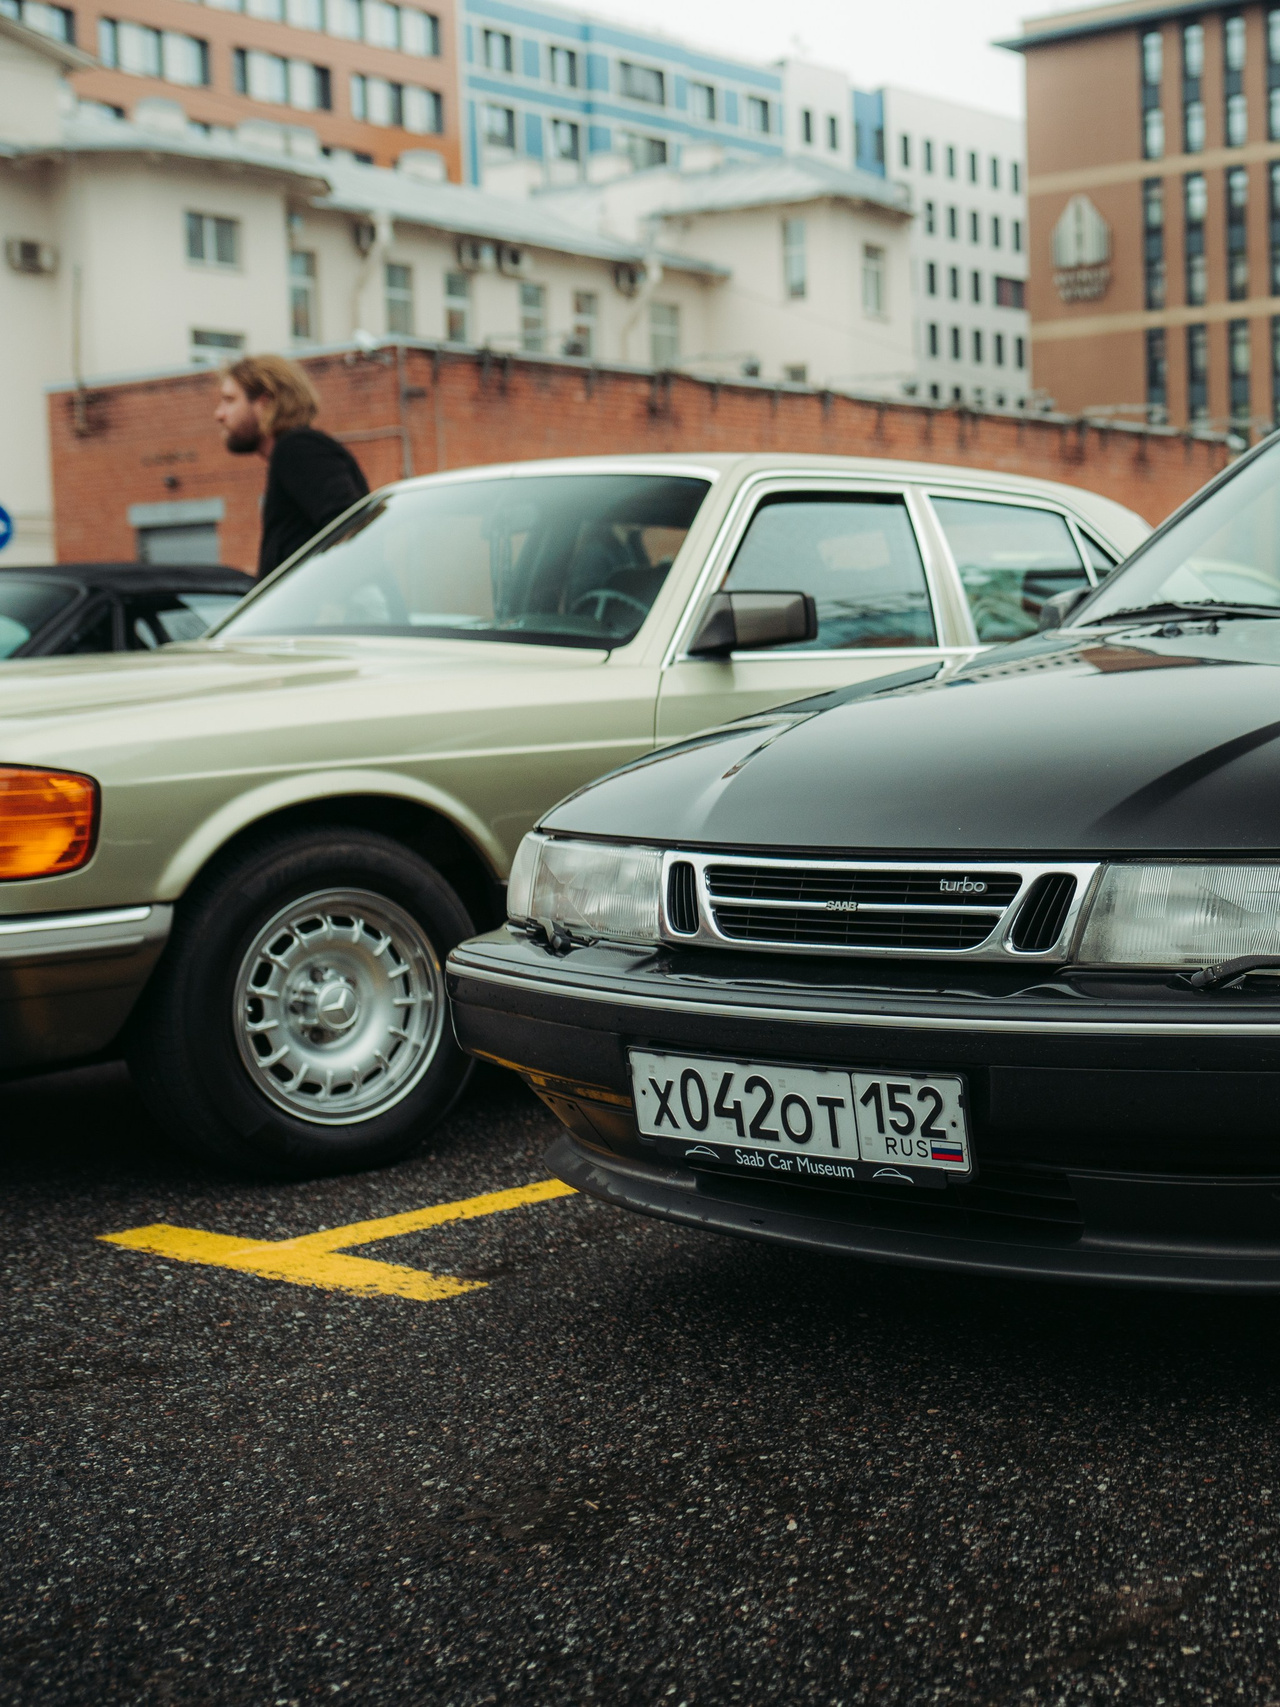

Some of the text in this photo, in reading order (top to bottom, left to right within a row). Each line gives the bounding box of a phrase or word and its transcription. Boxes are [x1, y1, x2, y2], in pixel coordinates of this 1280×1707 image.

[939, 876, 985, 893] turbo
[826, 900, 857, 911] SAAB
[860, 1081, 947, 1139] 152
[886, 1136, 929, 1158] RUS
[734, 1148, 855, 1178] Saab Car Museum
